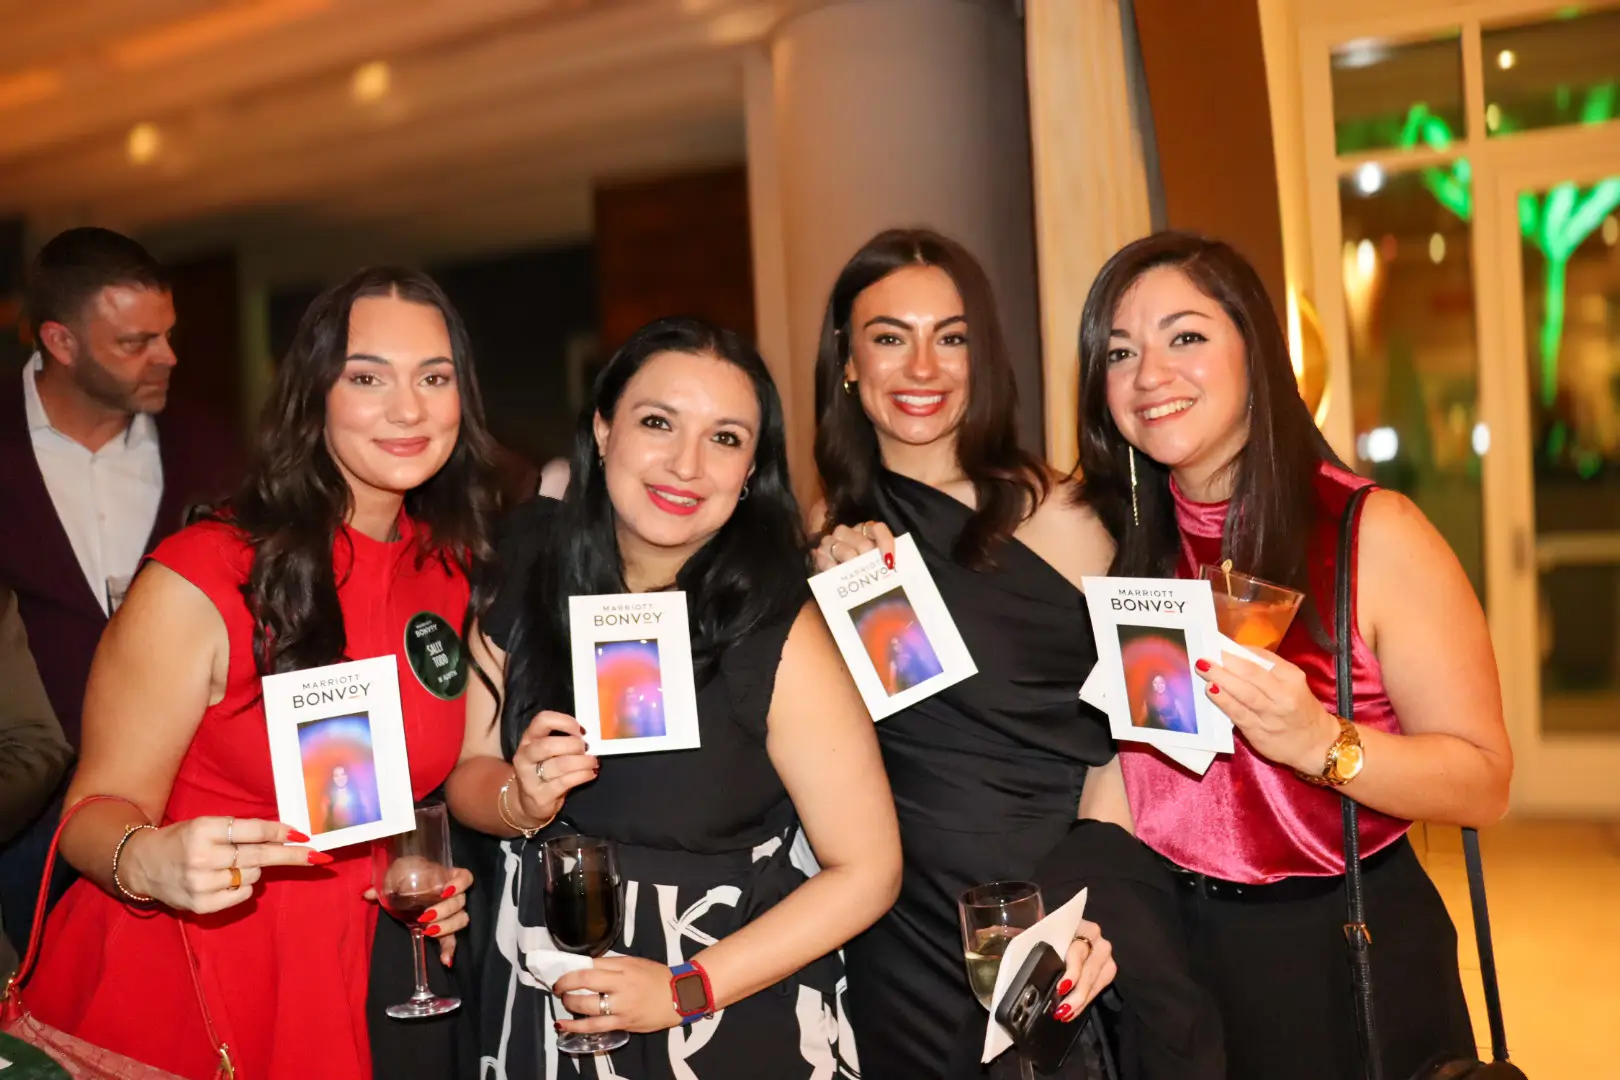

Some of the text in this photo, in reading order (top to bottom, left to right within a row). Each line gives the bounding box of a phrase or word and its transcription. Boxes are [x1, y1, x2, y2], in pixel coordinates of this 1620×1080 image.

[840, 558, 881, 580] MARRIOT
[1118, 588, 1174, 598] MARRIOTT
[602, 603, 653, 612] MARRIOTT
[1110, 598, 1186, 614] BONVOY
[593, 611, 663, 627] BONVOY
[302, 673, 360, 690] MARRIOTT
[292, 682, 371, 709] BONVOY
